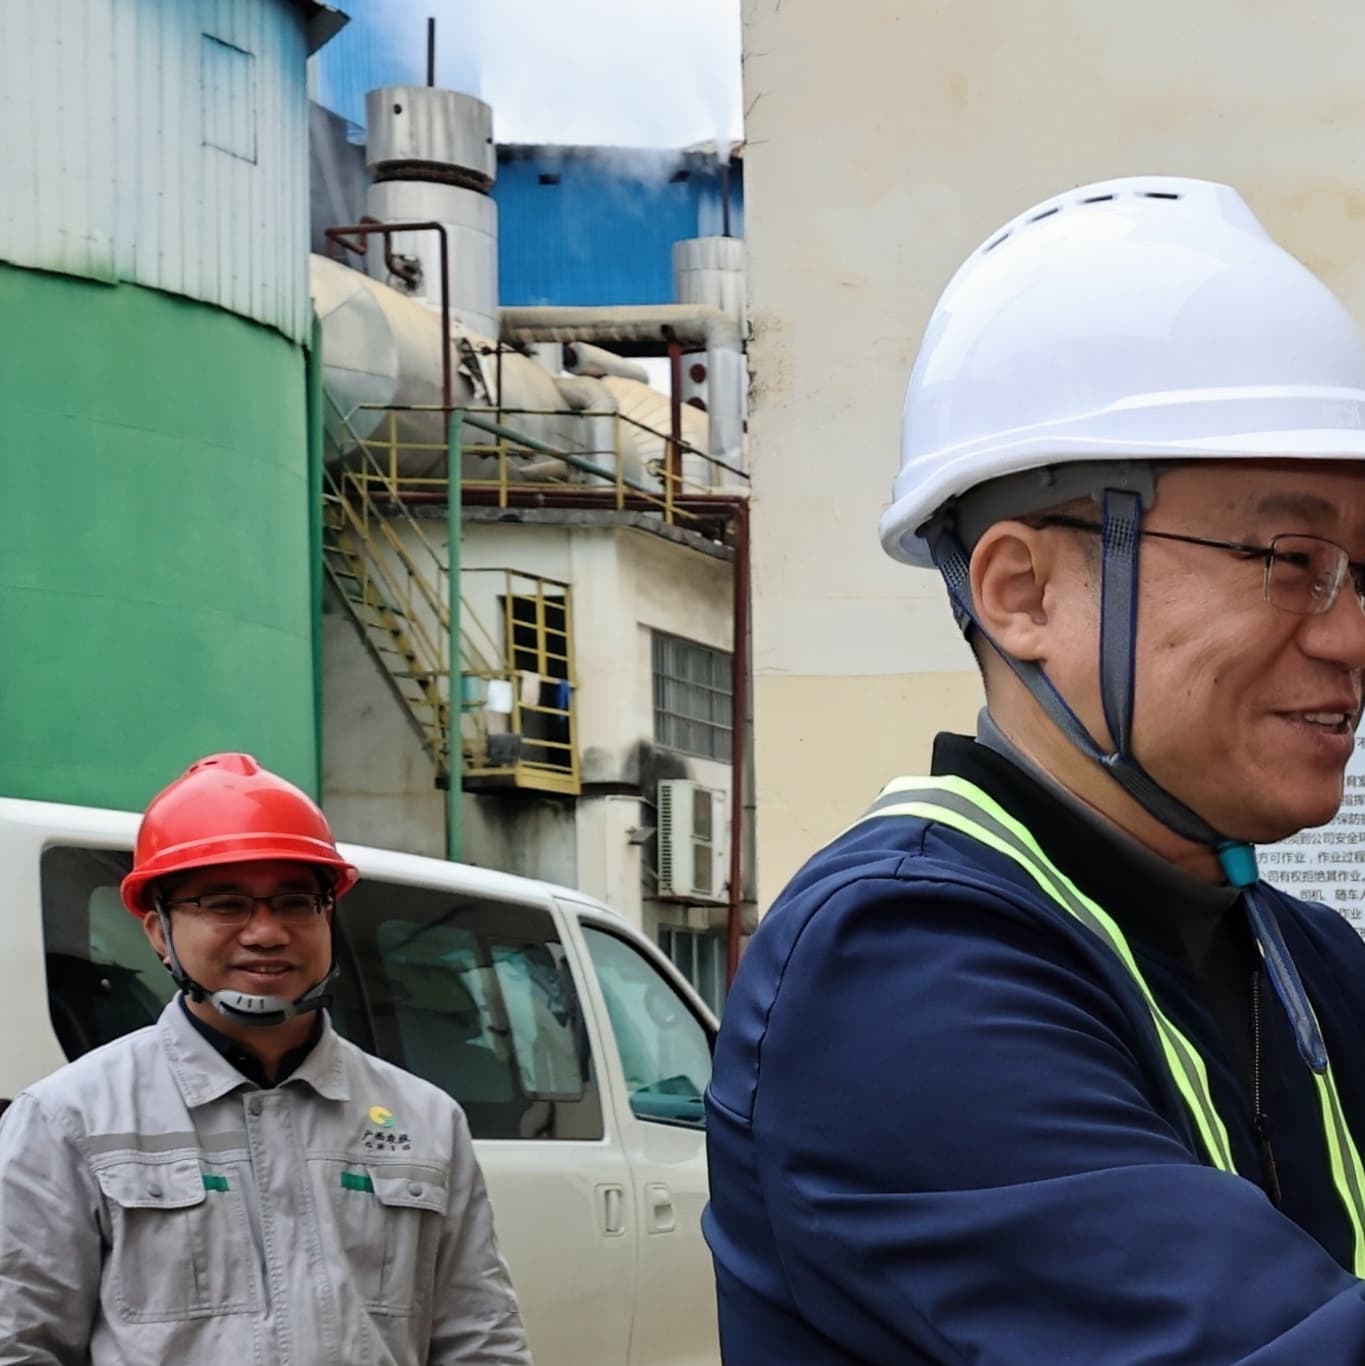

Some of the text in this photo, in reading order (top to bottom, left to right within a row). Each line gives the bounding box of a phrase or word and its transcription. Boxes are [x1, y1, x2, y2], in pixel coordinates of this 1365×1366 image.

[1262, 870, 1365, 882] 司有权拒绝其作业。
